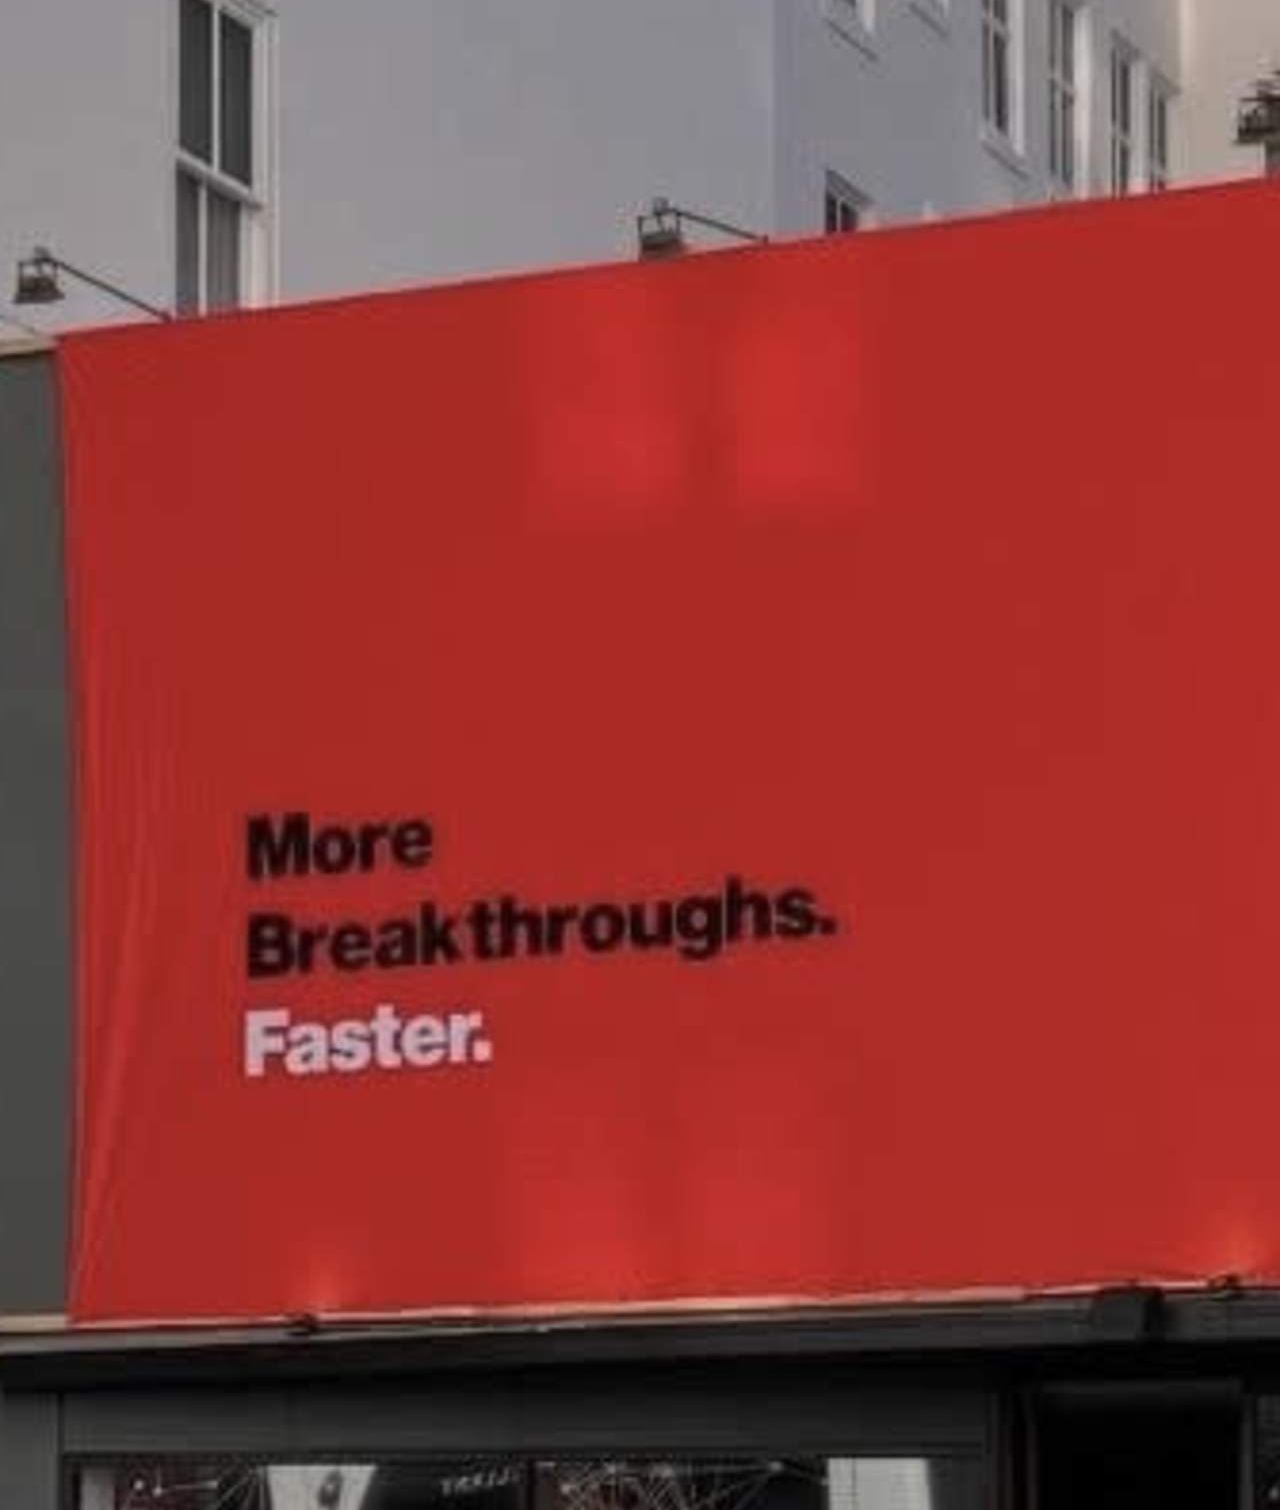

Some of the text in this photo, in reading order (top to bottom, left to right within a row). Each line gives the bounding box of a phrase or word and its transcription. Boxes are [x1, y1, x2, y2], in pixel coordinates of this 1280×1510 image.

[246, 813, 433, 879] More
[246, 877, 837, 977] Breakthroughs.
[244, 1005, 492, 1077] Faster.
